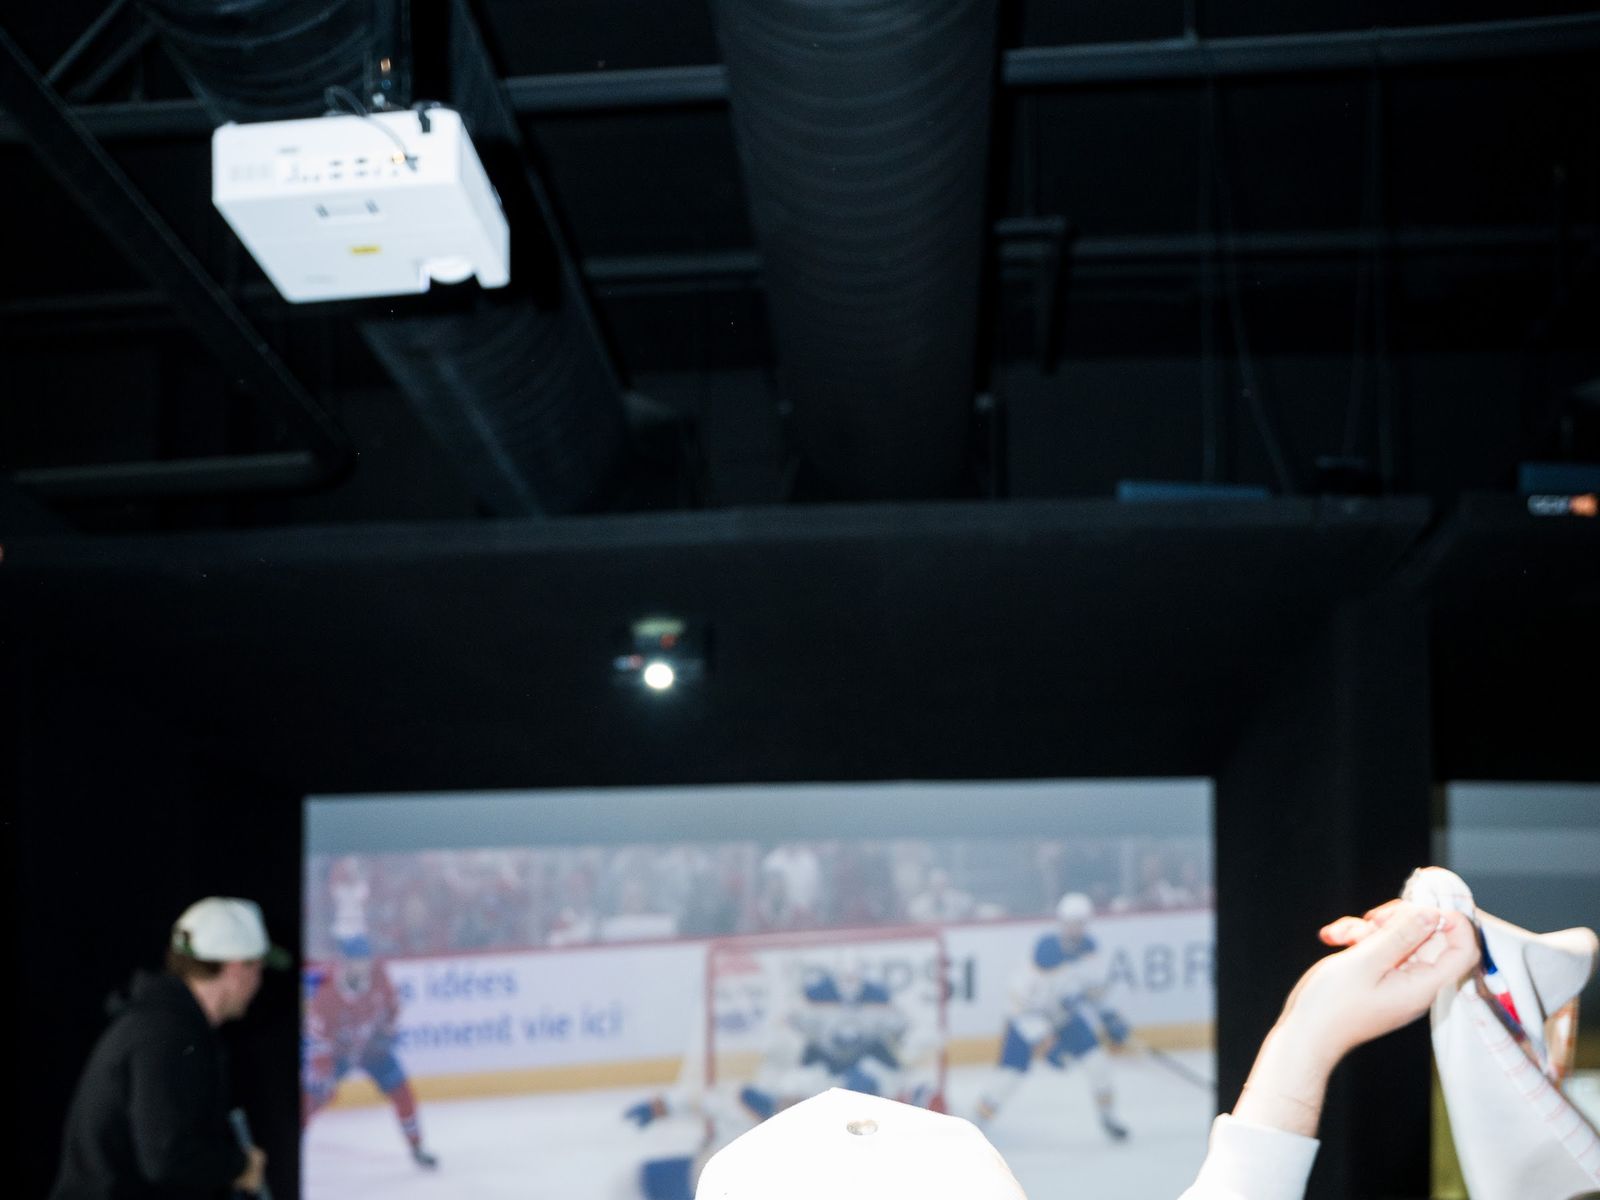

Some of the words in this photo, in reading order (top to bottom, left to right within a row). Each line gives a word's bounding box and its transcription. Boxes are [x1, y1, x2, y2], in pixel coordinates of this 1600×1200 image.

[427, 968, 519, 999] idées
[396, 1012, 512, 1047] ennent
[521, 1006, 571, 1043] vie
[581, 1000, 623, 1037] ici
